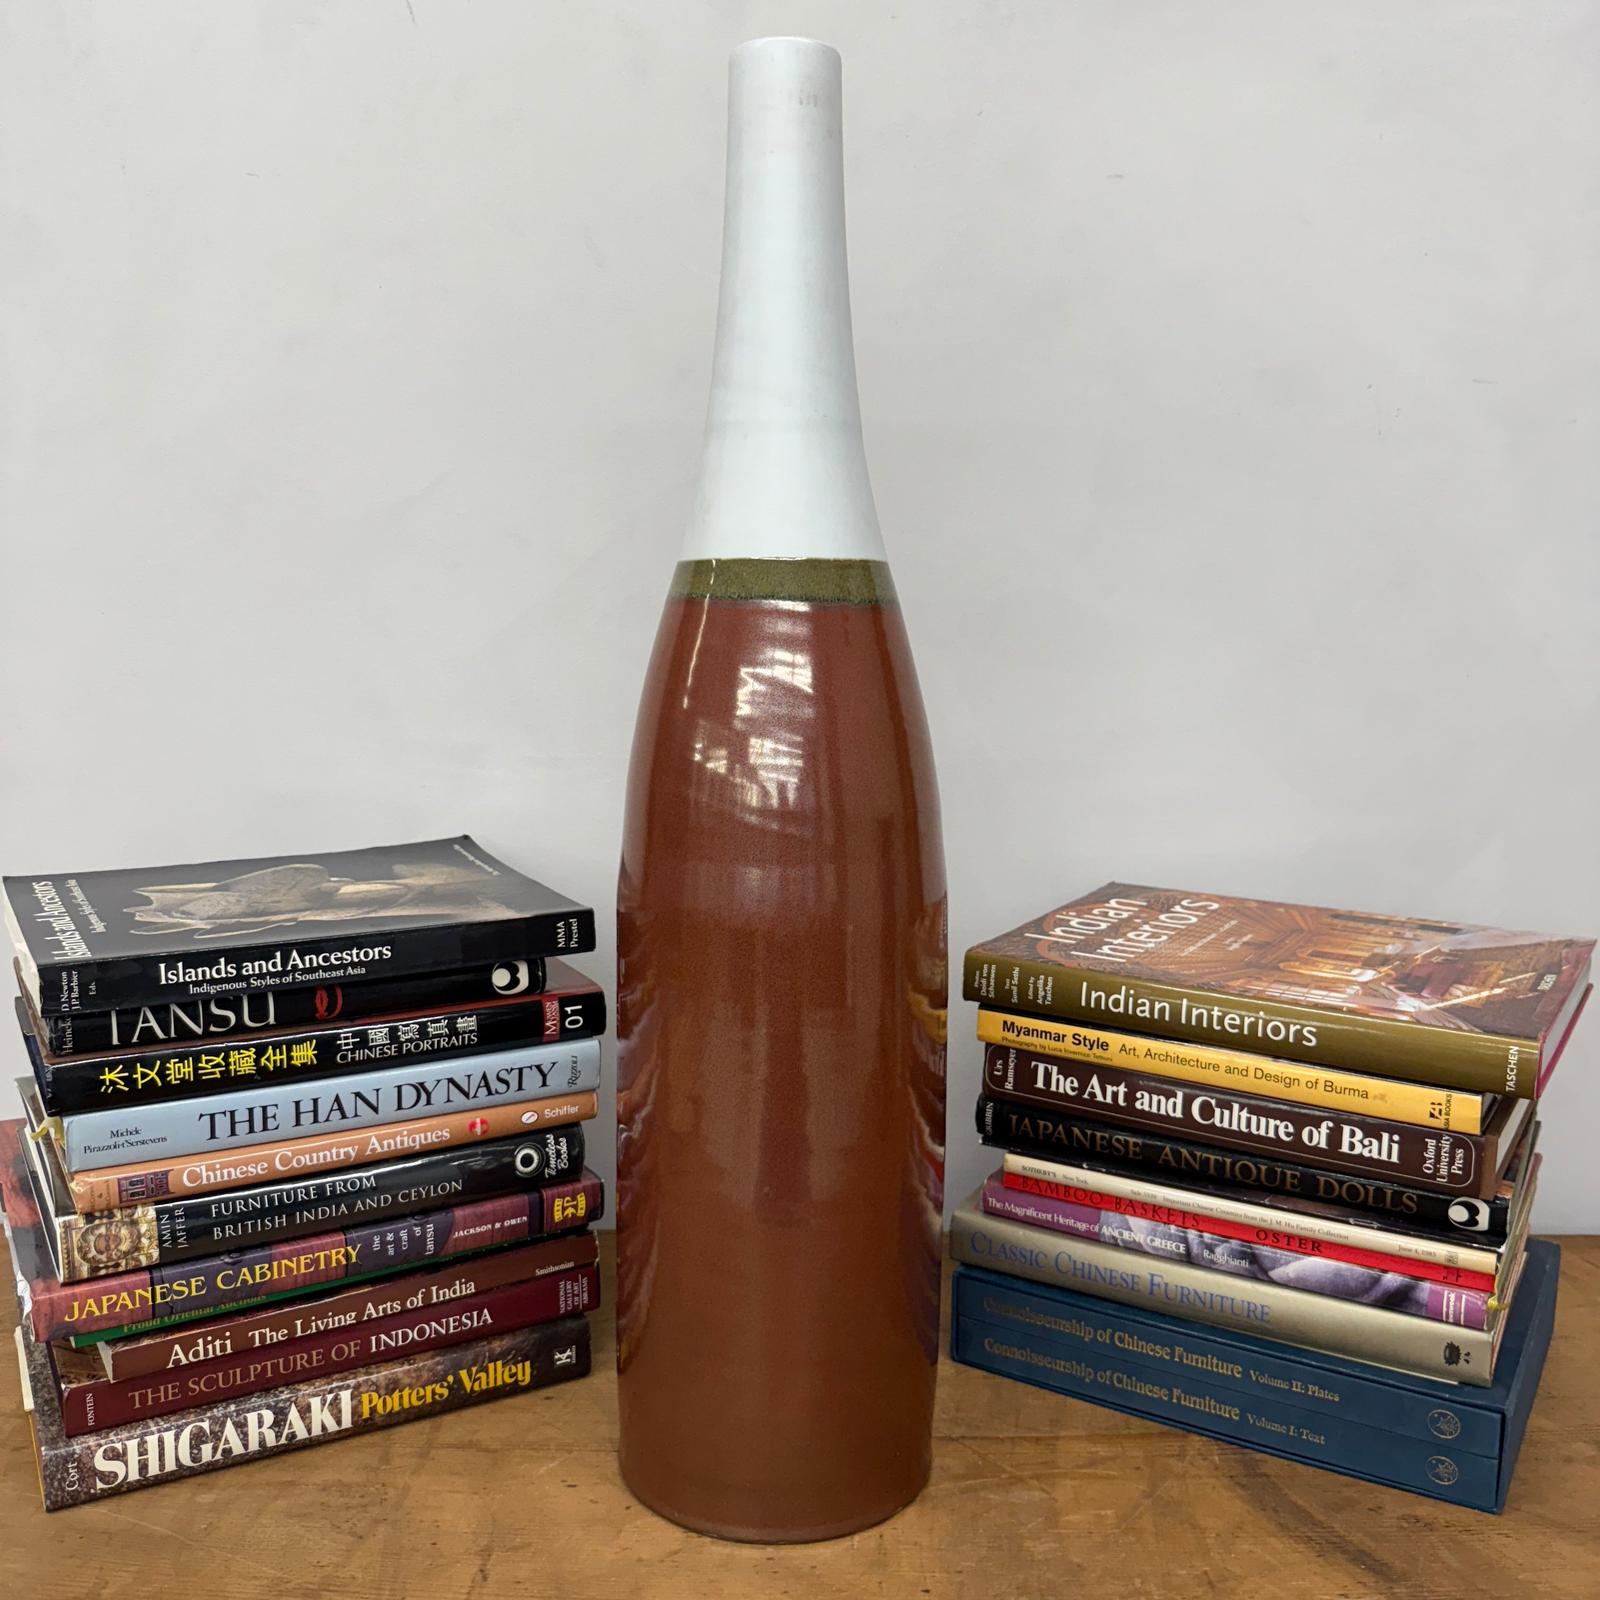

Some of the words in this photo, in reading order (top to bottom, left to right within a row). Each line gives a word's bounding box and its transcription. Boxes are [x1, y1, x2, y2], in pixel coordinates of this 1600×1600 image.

[32, 880, 69, 917] Ancestors
[557, 920, 566, 949] MMA
[569, 918, 579, 948] Prestel
[1024, 897, 1148, 945] Indian
[1071, 898, 1220, 963] Interiors
[44, 929, 92, 960] Islands
[158, 956, 236, 985] Islands
[242, 952, 283, 976] and
[287, 944, 392, 971] Ancestors
[189, 979, 247, 995] Indigenous
[250, 975, 281, 988] Styles
[283, 974, 294, 984] of
[295, 969, 345, 983] Southeast
[346, 965, 366, 977] Asia
[1011, 966, 1020, 985] Sethi
[60, 971, 68, 1002] Newton
[70, 971, 79, 996] Barbier
[980, 978, 988, 997] Deidi
[1010, 985, 1018, 1004] Sunil
[1036, 974, 1046, 1005] Angelika
[1045, 976, 1054, 1005] Taschen
[565, 1004, 584, 1030] 01
[1080, 981, 1171, 1024] Indian
[1181, 998, 1318, 1048] Interiors
[336, 1042, 399, 1065] CHINESE
[402, 1032, 479, 1055] PORTRAITS
[1002, 1020, 1068, 1043] Myanmar
[1071, 1033, 1109, 1051] Style
[1119, 1043, 1141, 1059] Art,
[1144, 1047, 1221, 1072] Architecture
[1224, 1063, 1249, 1078] and
[1254, 1067, 1301, 1091] Design
[1305, 1078, 1320, 1091] of
[1323, 1079, 1370, 1100] Burma
[99, 1037, 318, 1094] 沐文堂收藏全集
[993, 1058, 1004, 1076] Urs
[1004, 1048, 1017, 1091] Ramseyer
[1505, 1045, 1520, 1093] TASCHEN
[199, 1103, 281, 1142] THE
[292, 1087, 382, 1128] HAN
[394, 1061, 559, 1112] DYNASTY
[543, 1104, 580, 1118] Schiffer
[1031, 1061, 1080, 1090] The
[1082, 1076, 1128, 1107] Art
[1135, 1091, 1184, 1119] and
[1191, 1096, 1295, 1142] Culture
[1302, 1120, 1333, 1150] of
[1338, 1124, 1401, 1164] Bali
[1444, 1093, 1454, 1115] BOOKS
[182, 1155, 269, 1188] Chinese
[275, 1145, 359, 1174] Country
[366, 1128, 451, 1156] Antiques
[544, 1133, 556, 1181] Timeless
[557, 1136, 568, 1170] Books
[1009, 1113, 1144, 1160] JAPANESE
[1158, 1144, 1301, 1192] ANTIQUE
[1317, 1176, 1418, 1215] DOLLS
[1422, 1138, 1437, 1174] Oxford
[1436, 1134, 1453, 1183] University
[1450, 1148, 1465, 1176] Press
[211, 1184, 318, 1218] FURNITURE
[325, 1174, 377, 1198] FROM
[213, 1214, 288, 1241] BRITISH
[296, 1202, 349, 1225] INDIA
[354, 1193, 393, 1214] AND
[398, 1179, 464, 1205] CEYLON
[1114, 1196, 1200, 1228] BASKETS
[162, 1214, 173, 1248] AMIN
[174, 1207, 186, 1249] JAFFER
[387, 1231, 396, 1241] &
[399, 1228, 409, 1250] craft
[413, 1225, 422, 1237] of
[424, 1223, 435, 1256] tansu
[452, 1223, 493, 1239] JACKSON
[494, 1220, 502, 1230] &
[503, 1215, 528, 1229] OWEN
[987, 1196, 1004, 1210] The
[1004, 1202, 1053, 1223] Magnificent
[1053, 1212, 1090, 1232] Heritage
[1090, 1222, 1100, 1233] of
[1101, 1224, 1145, 1244] ANCIENT
[1146, 1236, 1186, 1254] GREECE
[1244, 1211, 1258, 1221] from
[1296, 1223, 1317, 1234] Family
[1318, 1227, 1349, 1241] Collection
[1256, 1229, 1322, 1253] OSTER
[372, 1234, 382, 1252] the
[387, 1241, 395, 1256] art
[1203, 1248, 1249, 1268] Ragghianti
[64, 1275, 207, 1323] JAPANESE
[216, 1243, 363, 1291] CABINETRY
[535, 1260, 575, 1276] Smithsonian
[971, 1231, 1049, 1269] CLASSIC
[1055, 1250, 1141, 1292] CHINESE
[1147, 1271, 1272, 1323] FURNITURE
[166, 1331, 233, 1369] Aditi
[248, 1326, 289, 1348] The
[295, 1311, 357, 1337] Living
[362, 1299, 401, 1321] Arts
[406, 1288, 426, 1309] of
[431, 1279, 476, 1303] India
[128, 1382, 182, 1409] THE
[188, 1349, 325, 1397] SCULPTURE
[331, 1340, 361, 1362] OF
[369, 1307, 494, 1353] INDONESIA
[1096, 1327, 1112, 1344] of
[1114, 1331, 1171, 1360] Chinese
[1174, 1345, 1242, 1378] Furniture
[1249, 1370, 1290, 1391] Volume
[1307, 1384, 1340, 1402] Plates
[983, 1337, 1095, 1382] Connoisseurship
[1096, 1369, 1113, 1385] of
[1113, 1371, 1169, 1401] Chinese
[1171, 1387, 1240, 1421] Furniture
[1246, 1412, 1287, 1435] Volume
[1299, 1427, 1325, 1446] Text
[87, 1393, 96, 1427] FONTEIN
[93, 1389, 353, 1490] SHIGARAKI
[458, 1359, 532, 1394] Valley
[65, 1461, 79, 1491] Cort
